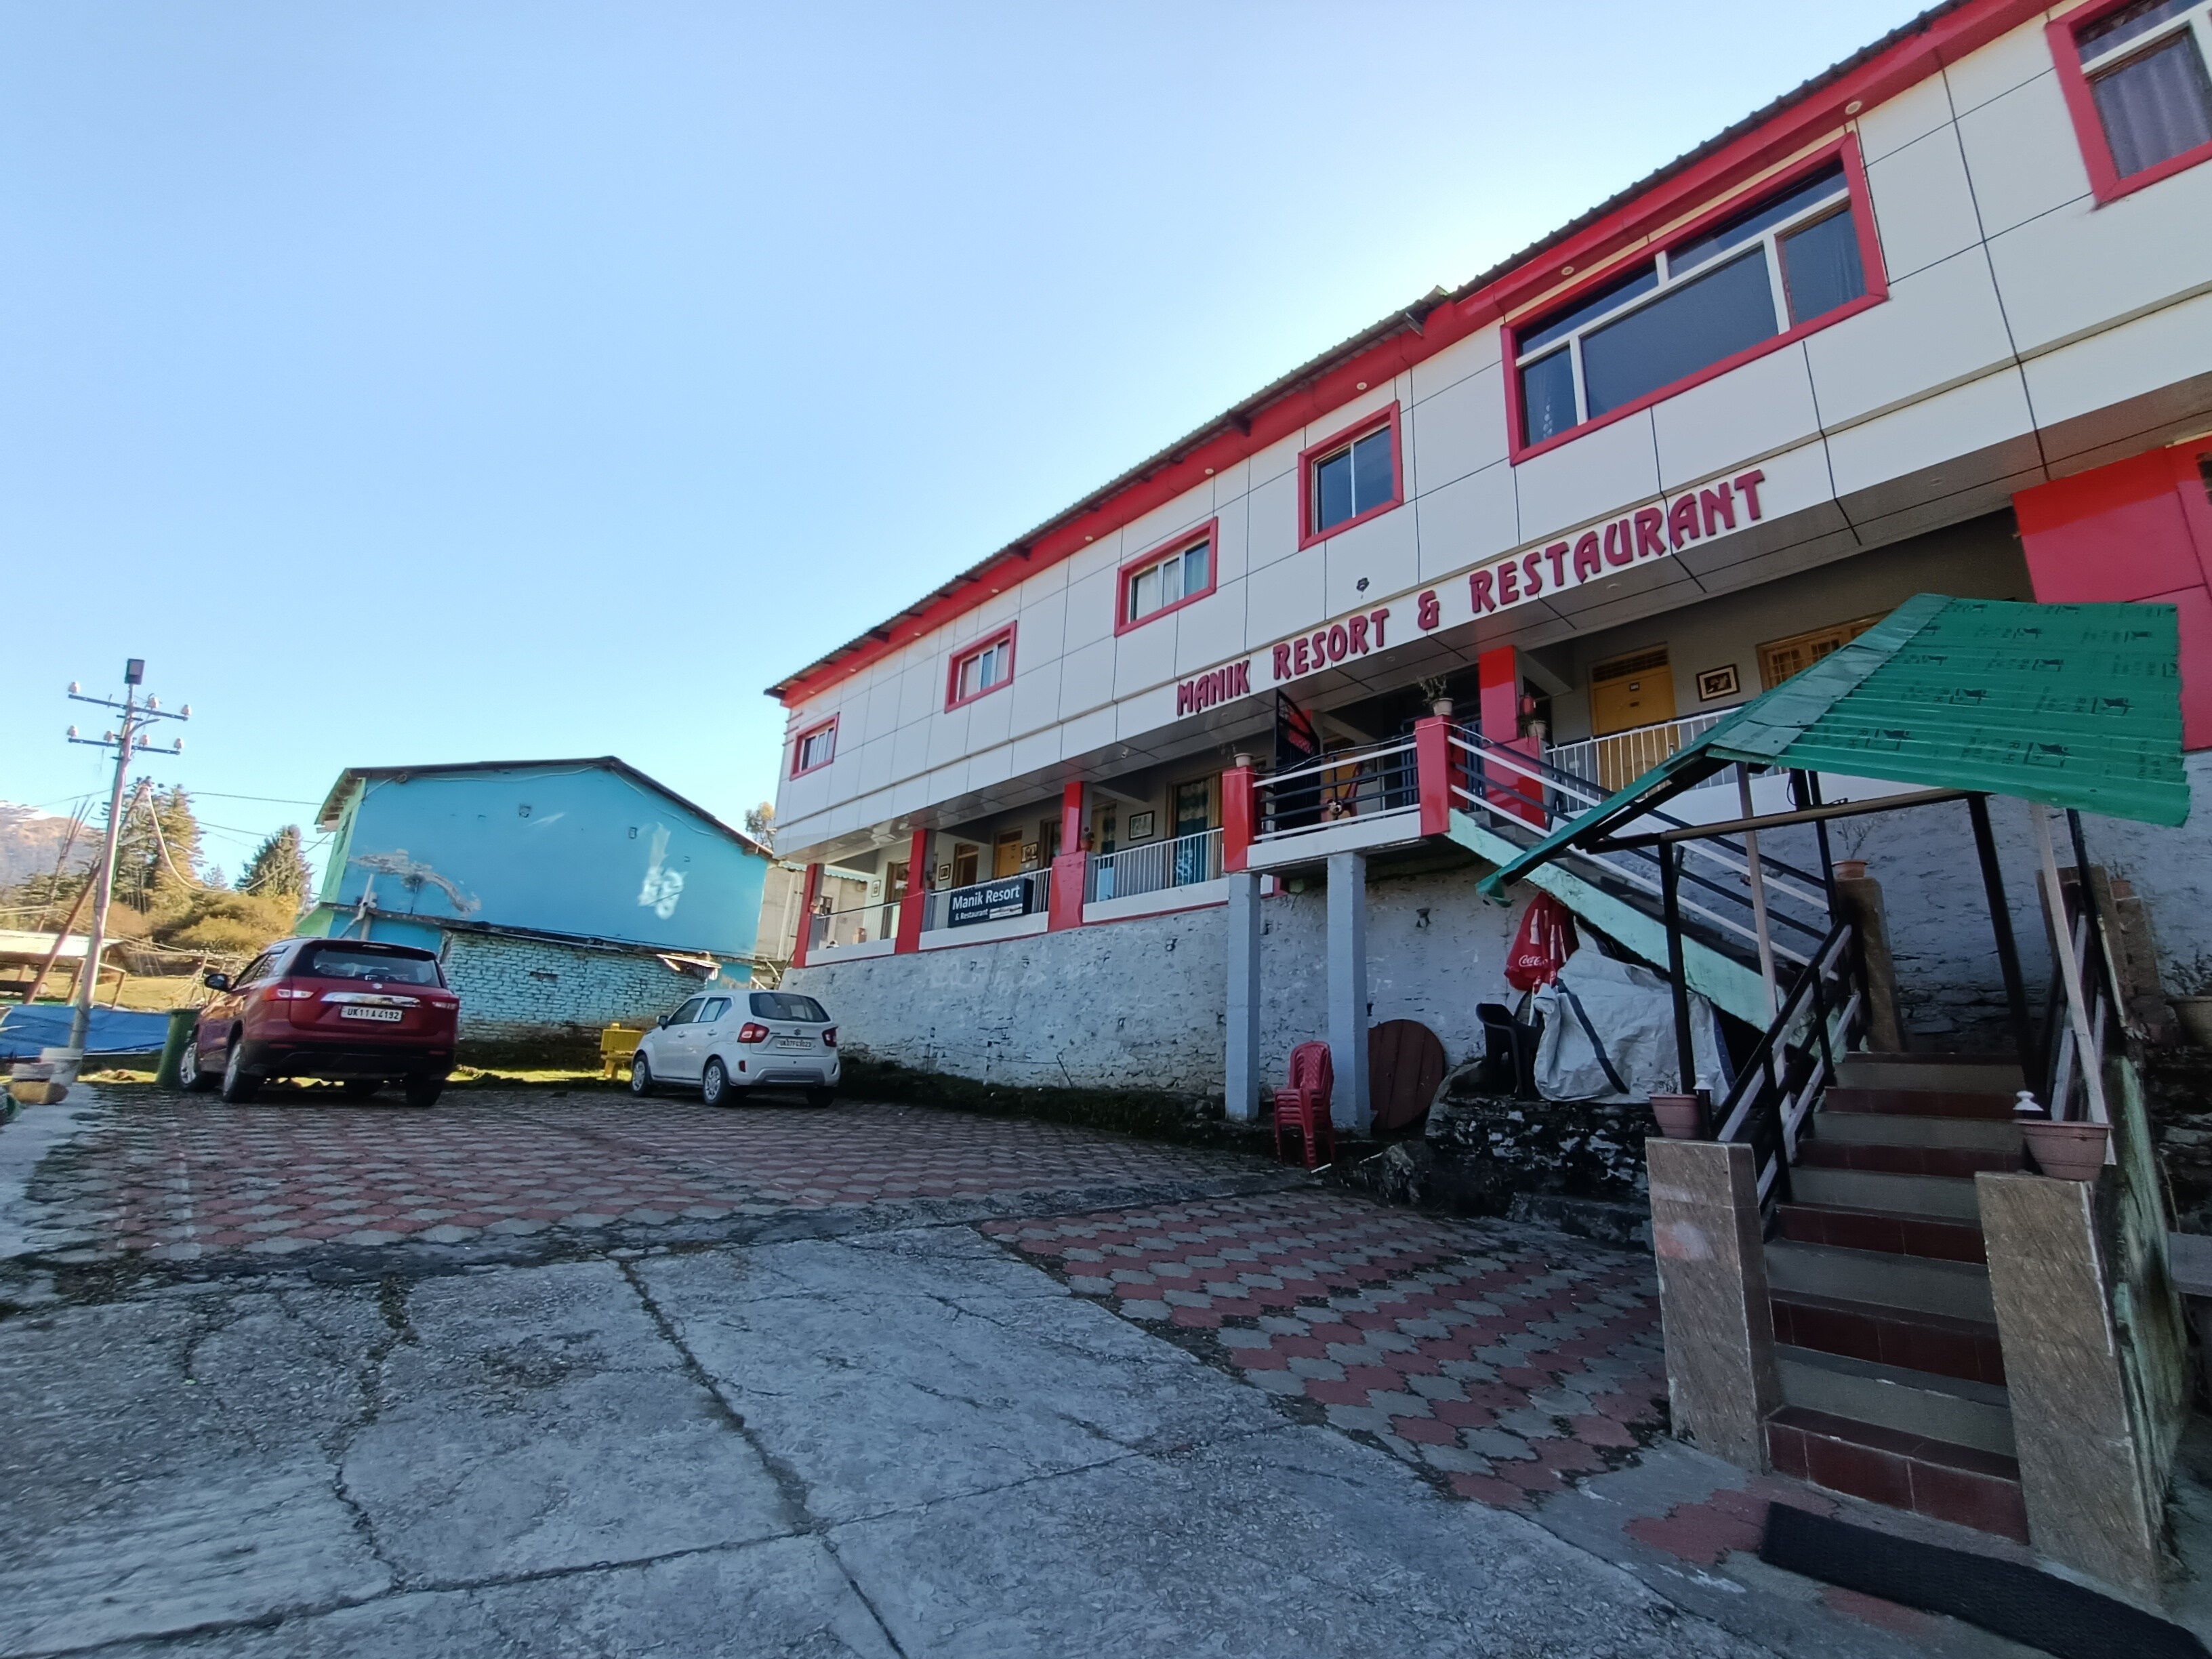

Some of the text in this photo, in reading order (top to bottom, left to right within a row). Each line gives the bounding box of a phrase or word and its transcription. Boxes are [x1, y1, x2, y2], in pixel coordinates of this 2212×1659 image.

[1176, 468, 1765, 716] MANIK RESORT & RESTAURANT
[952, 885, 1020, 910] Manik Resort
[955, 913, 960, 921] &
[960, 908, 988, 920] Restaurant
